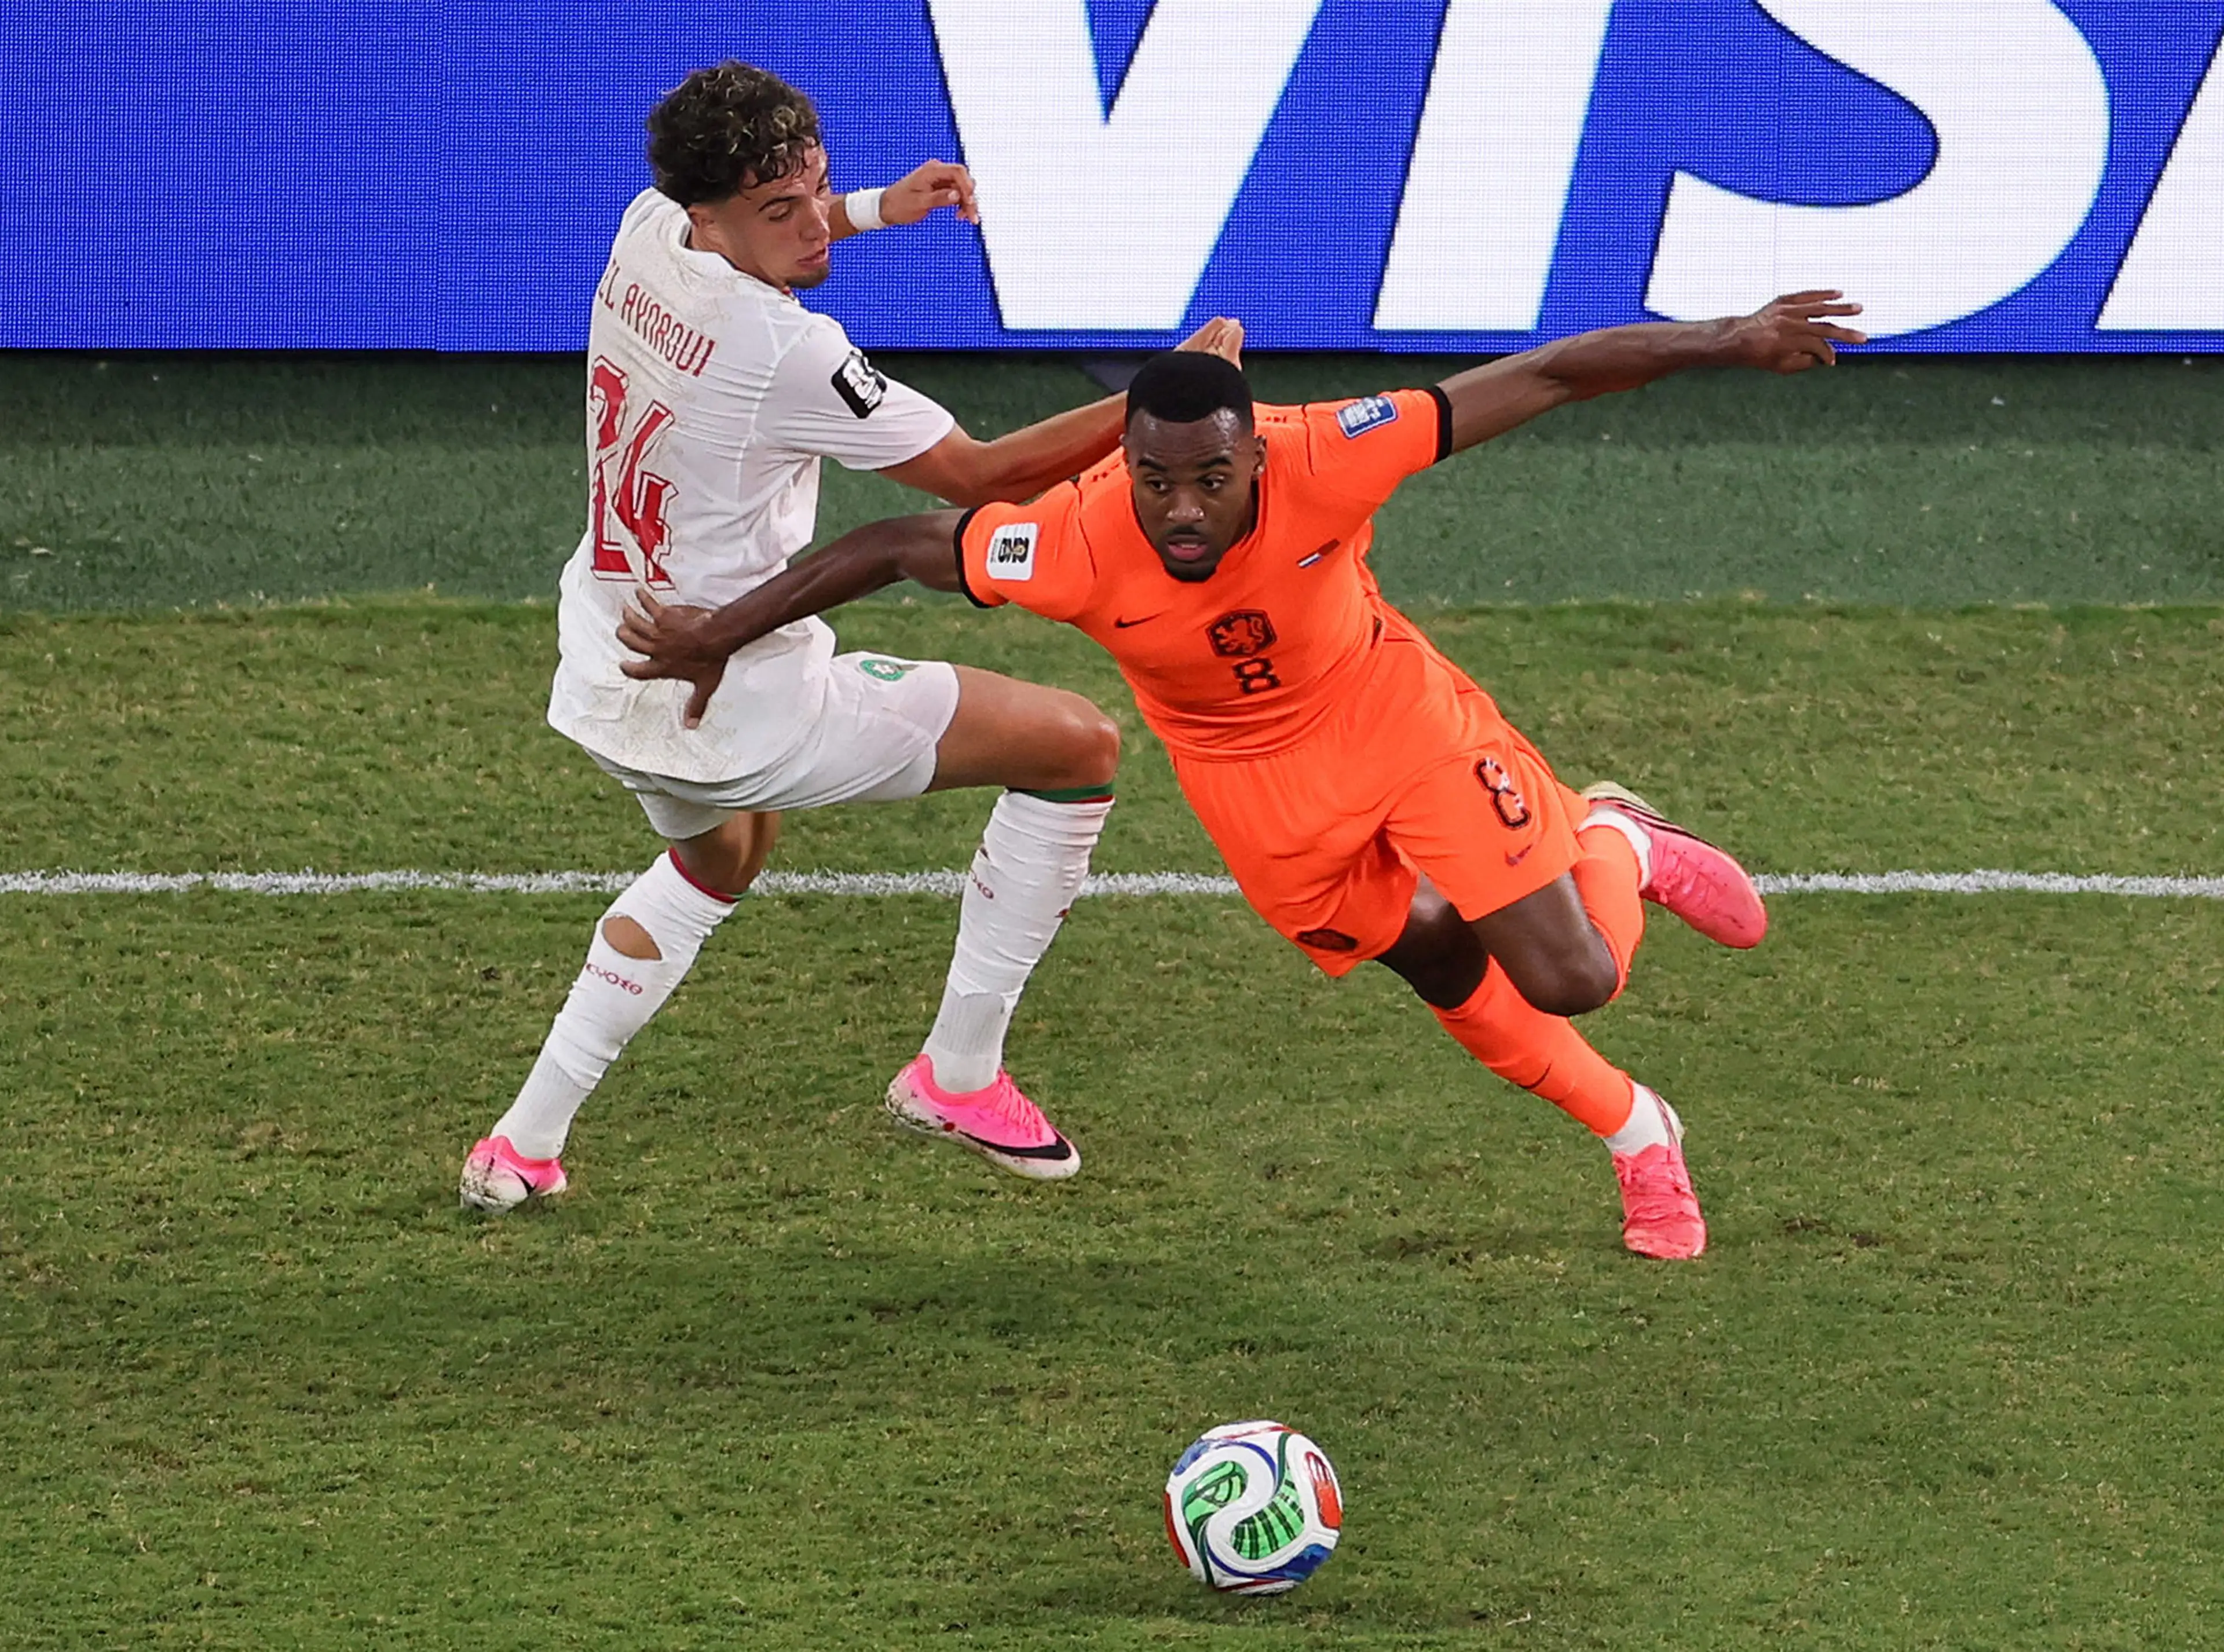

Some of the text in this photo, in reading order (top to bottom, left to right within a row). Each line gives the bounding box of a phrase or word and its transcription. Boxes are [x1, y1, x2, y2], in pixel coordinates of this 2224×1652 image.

[929, 0, 2224, 338] VIS
[1231, 657, 1281, 695] 8
[1473, 756, 1532, 831] 8
